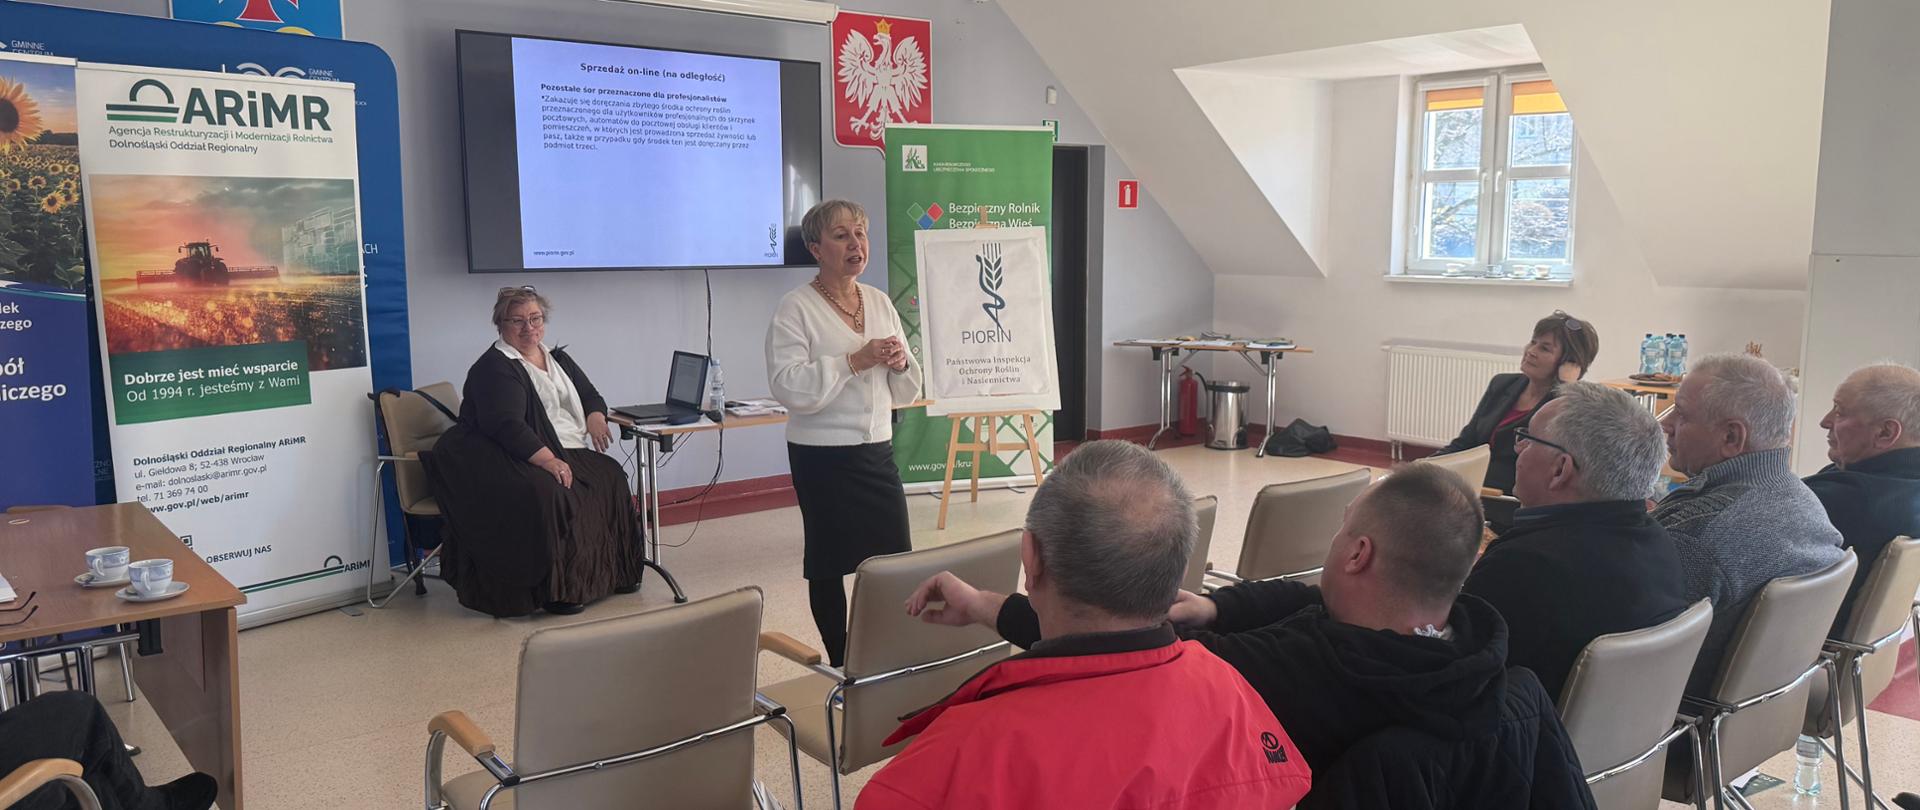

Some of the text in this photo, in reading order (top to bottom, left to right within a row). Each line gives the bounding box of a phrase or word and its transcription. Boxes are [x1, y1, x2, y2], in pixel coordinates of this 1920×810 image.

[11, 40, 45, 50] GMINNE
[580, 63, 725, 82] Sprzedaż on-line (na odległość)
[653, 91, 665, 99] dla
[667, 93, 727, 103] profesjonalistów
[182, 87, 332, 131] ARiMR
[541, 105, 601, 116] przeznaczonego
[602, 108, 613, 116] dla
[615, 109, 663, 119] użytkowników
[589, 116, 629, 126] automatów
[641, 120, 676, 129] pocztowej
[701, 122, 729, 131] klientów
[108, 126, 151, 137] Agencja
[153, 127, 229, 140] Restrukturyzacji
[235, 131, 291, 143] Modernizacji
[293, 134, 334, 143] Rolnictwa
[602, 126, 628, 136] których
[629, 128, 643, 136] jest
[644, 129, 685, 138] prowadzona
[109, 139, 258, 154] Dolnośląski Oddział Regionalny
[543, 141, 574, 150] podmiot
[594, 135, 631, 145] przypadku
[632, 137, 646, 146] gdy
[684, 139, 697, 148] jest
[732, 142, 750, 150] przez
[949, 202, 1041, 215] Bezpizny Rolnik
[1008, 218, 1033, 228] Wieś
[362, 244, 378, 254] CH
[961, 328, 1012, 344] PIORIN
[946, 355, 1031, 366] Państwowa Inspekcja
[124, 360, 299, 386] Dobrze jest mieć wsparcie
[959, 364, 1020, 376] Ochrony Roślin
[967, 375, 1021, 385] Nasiennictwa
[0, 384, 67, 401] iczego
[126, 375, 301, 403] Od 1994 r. jesteśmy z Wami
[133, 436, 306, 467] Dolnośląski Oddział Regionalny ARiMR
[134, 470, 146, 479] ul.
[189, 462, 198, 472] 8;
[200, 457, 229, 470] 52-438
[135, 479, 166, 491] e-mail:
[137, 484, 208, 503] tel. 71 369 74 00
[150, 491, 250, 513] ww.gov.pl/web/arimr
[206, 544, 272, 564] OBSERWUJ NAS
[344, 559, 370, 573] ARiM
